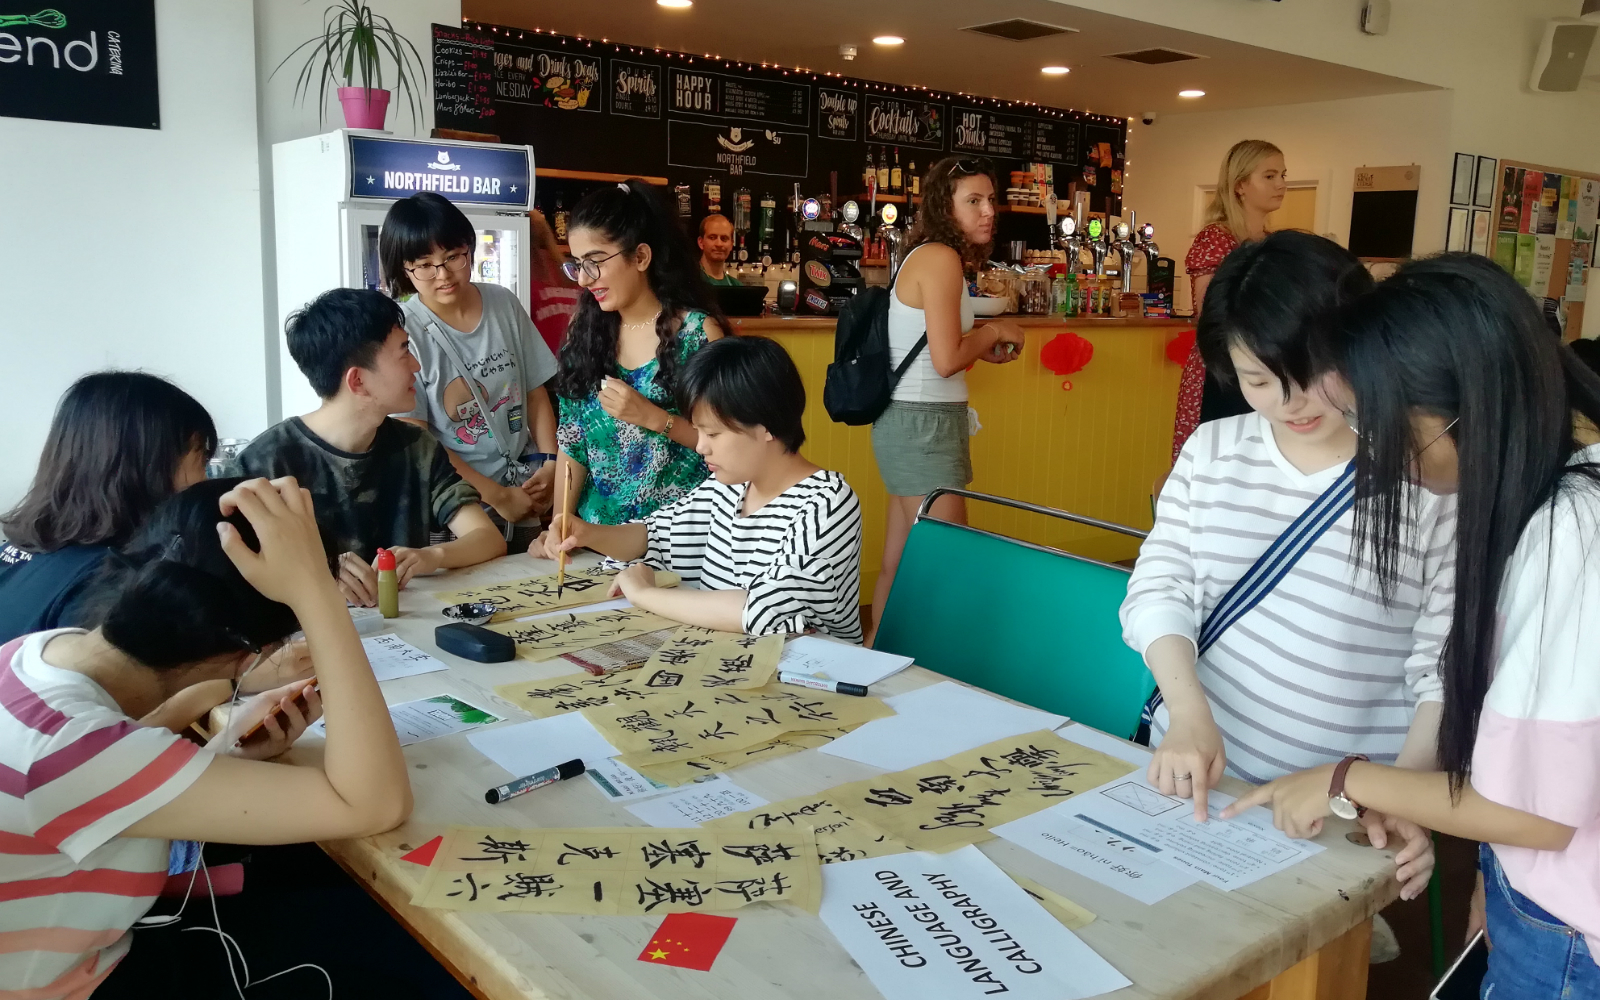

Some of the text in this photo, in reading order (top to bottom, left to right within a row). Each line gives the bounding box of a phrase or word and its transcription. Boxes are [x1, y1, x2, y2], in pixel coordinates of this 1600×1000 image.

[107, 30, 123, 75] CATERING
[435, 44, 463, 55] Cookies
[434, 56, 455, 68] Crisps
[516, 54, 534, 72] and
[537, 53, 572, 78] Drinks
[574, 58, 599, 82] Deals
[435, 79, 456, 88] Haribo
[495, 81, 532, 99] NESDAY
[616, 71, 657, 96] Spirits
[676, 74, 712, 92] HAPPY
[435, 90, 470, 103] Lumberjack
[676, 91, 712, 111] HOUR
[820, 92, 846, 111] Double
[436, 103, 453, 112] Mars
[887, 102, 899, 111] FOR
[868, 106, 920, 134] Cocktails
[963, 112, 983, 127] HOT
[772, 136, 781, 145] SU
[956, 124, 986, 147] Drinks
[716, 153, 757, 166] NORTHFIELD
[729, 165, 743, 175] BAR
[384, 171, 501, 195] NORTHFIELD BAR
[808, 236, 829, 252] Mars
[809, 264, 828, 281] Twix
[806, 294, 829, 309] SNICKERS
[1040, 832, 1070, 847] Hello
[1172, 855, 1229, 884] Four Main Tones
[921, 873, 1043, 974] CALLIGRAPHY
[852, 901, 927, 968] CHINESE
[874, 870, 1009, 995] LANGUAGE AND
